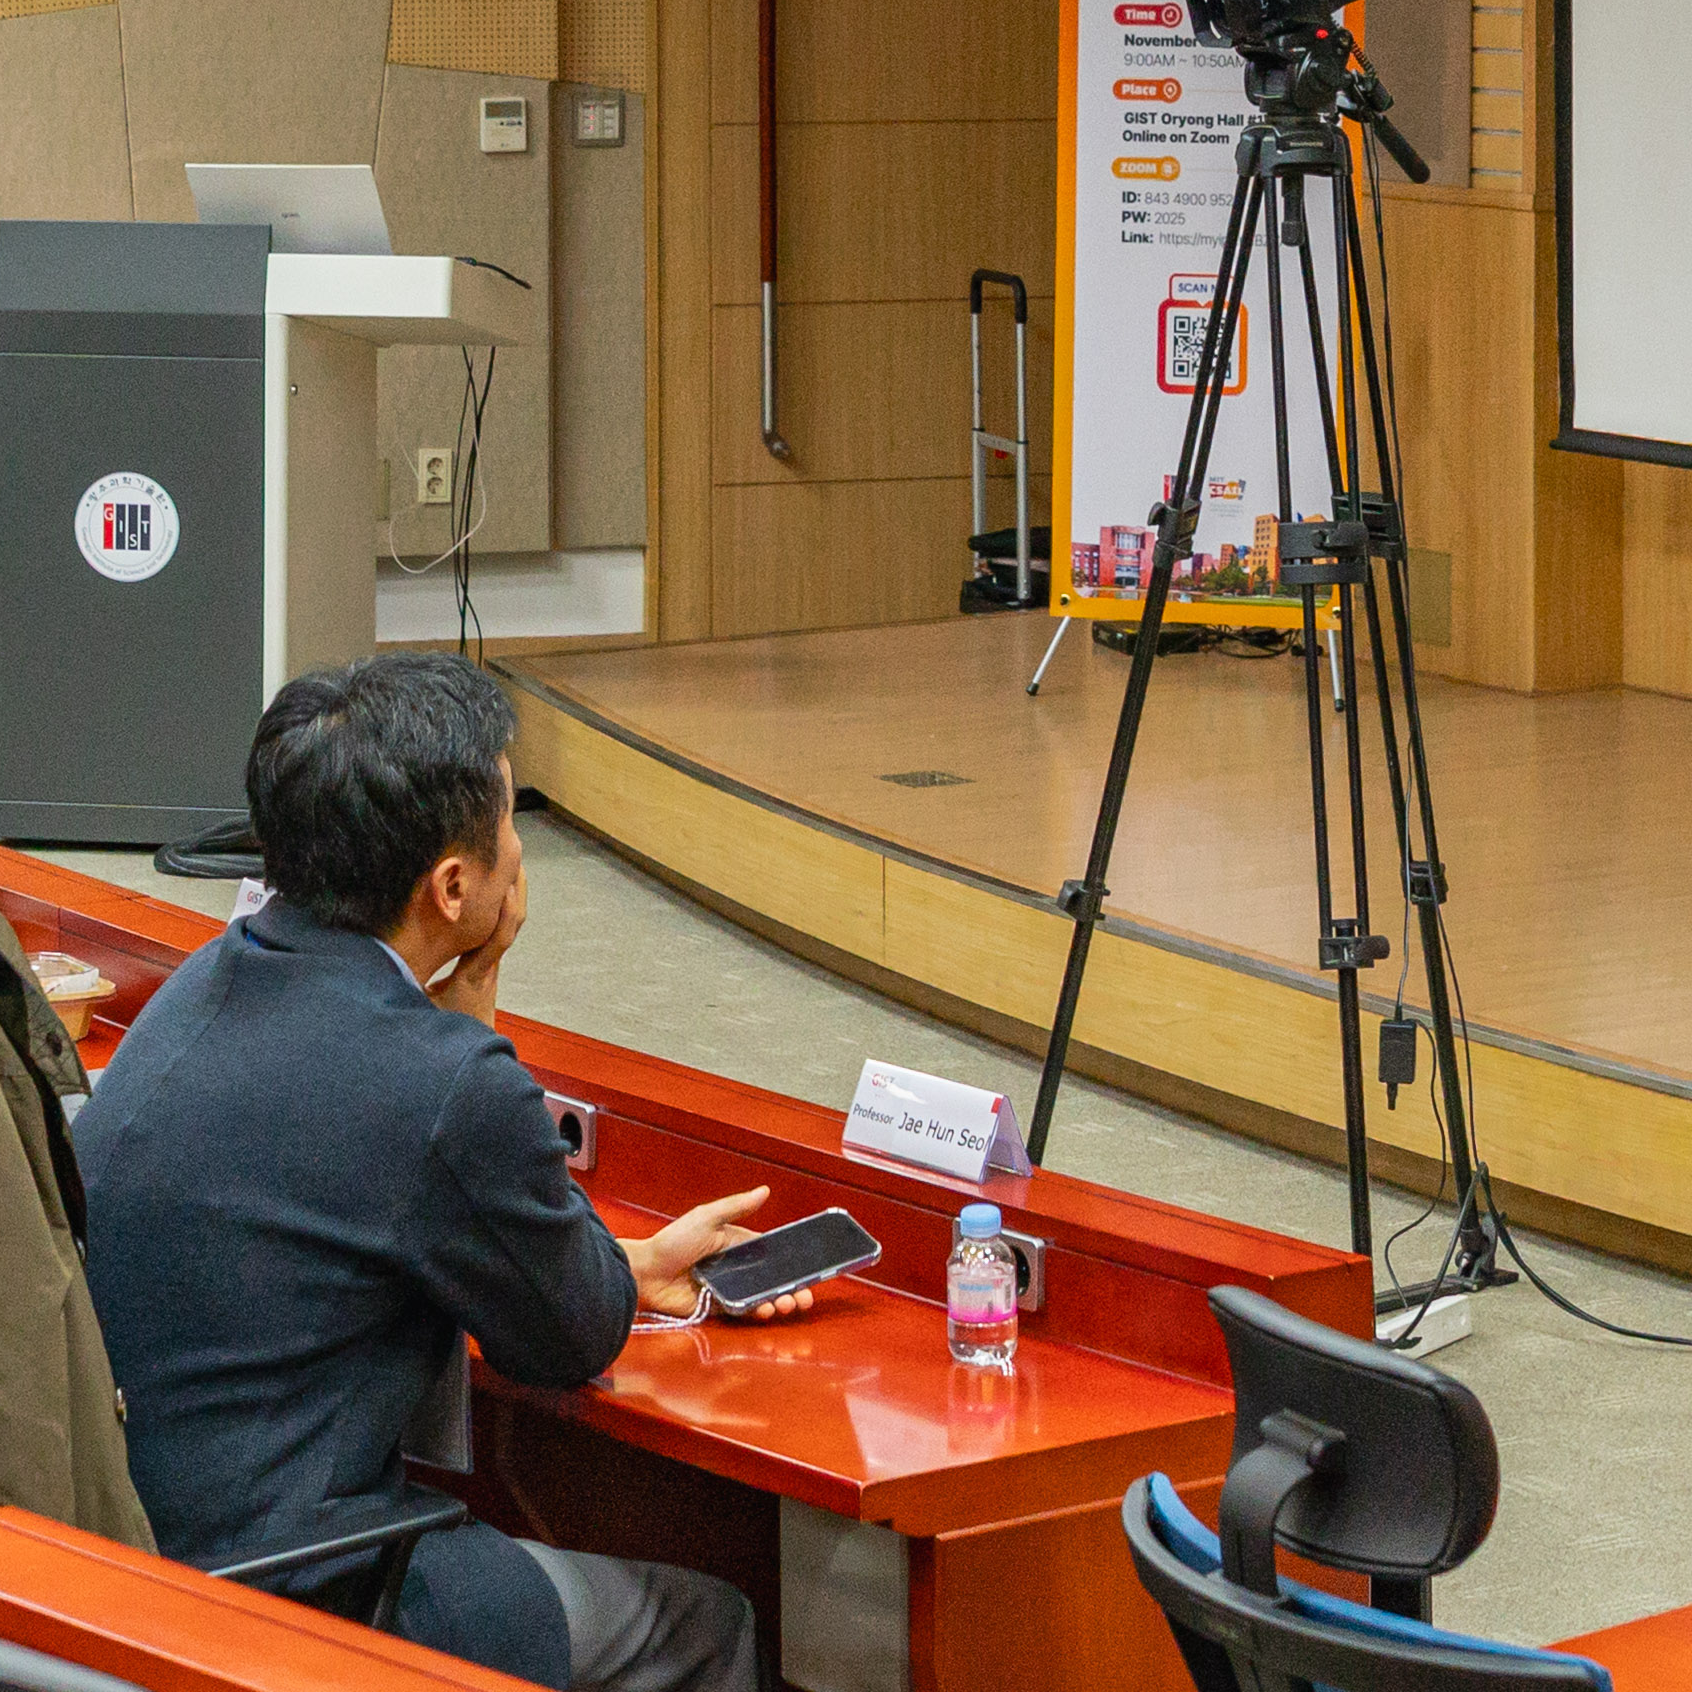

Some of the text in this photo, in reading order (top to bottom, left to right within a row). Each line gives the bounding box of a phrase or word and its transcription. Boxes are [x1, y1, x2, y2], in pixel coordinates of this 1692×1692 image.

[1124, 9, 1156, 21] Time
[1124, 34, 1197, 47] November
[1124, 53, 1175, 67] 9:00AM
[1121, 83, 1157, 95] Place
[1124, 112, 1157, 124] GIST
[1161, 113, 1214, 128] Oryong
[1217, 114, 1244, 126] Hall
[1122, 130, 1229, 144] Online on Zoom
[1120, 162, 1157, 174] ZOOM
[1122, 191, 1141, 203] ID:
[1145, 192, 1169, 204] 843
[1173, 193, 1207, 206] 4900
[1122, 211, 1186, 225] PW: 2025
[1122, 231, 1154, 243] Link:
[1178, 283, 1208, 293] SCAN
[852, 1103, 895, 1125] Professor
[898, 1111, 923, 1134] Jae
[926, 1119, 955, 1143] Hun
